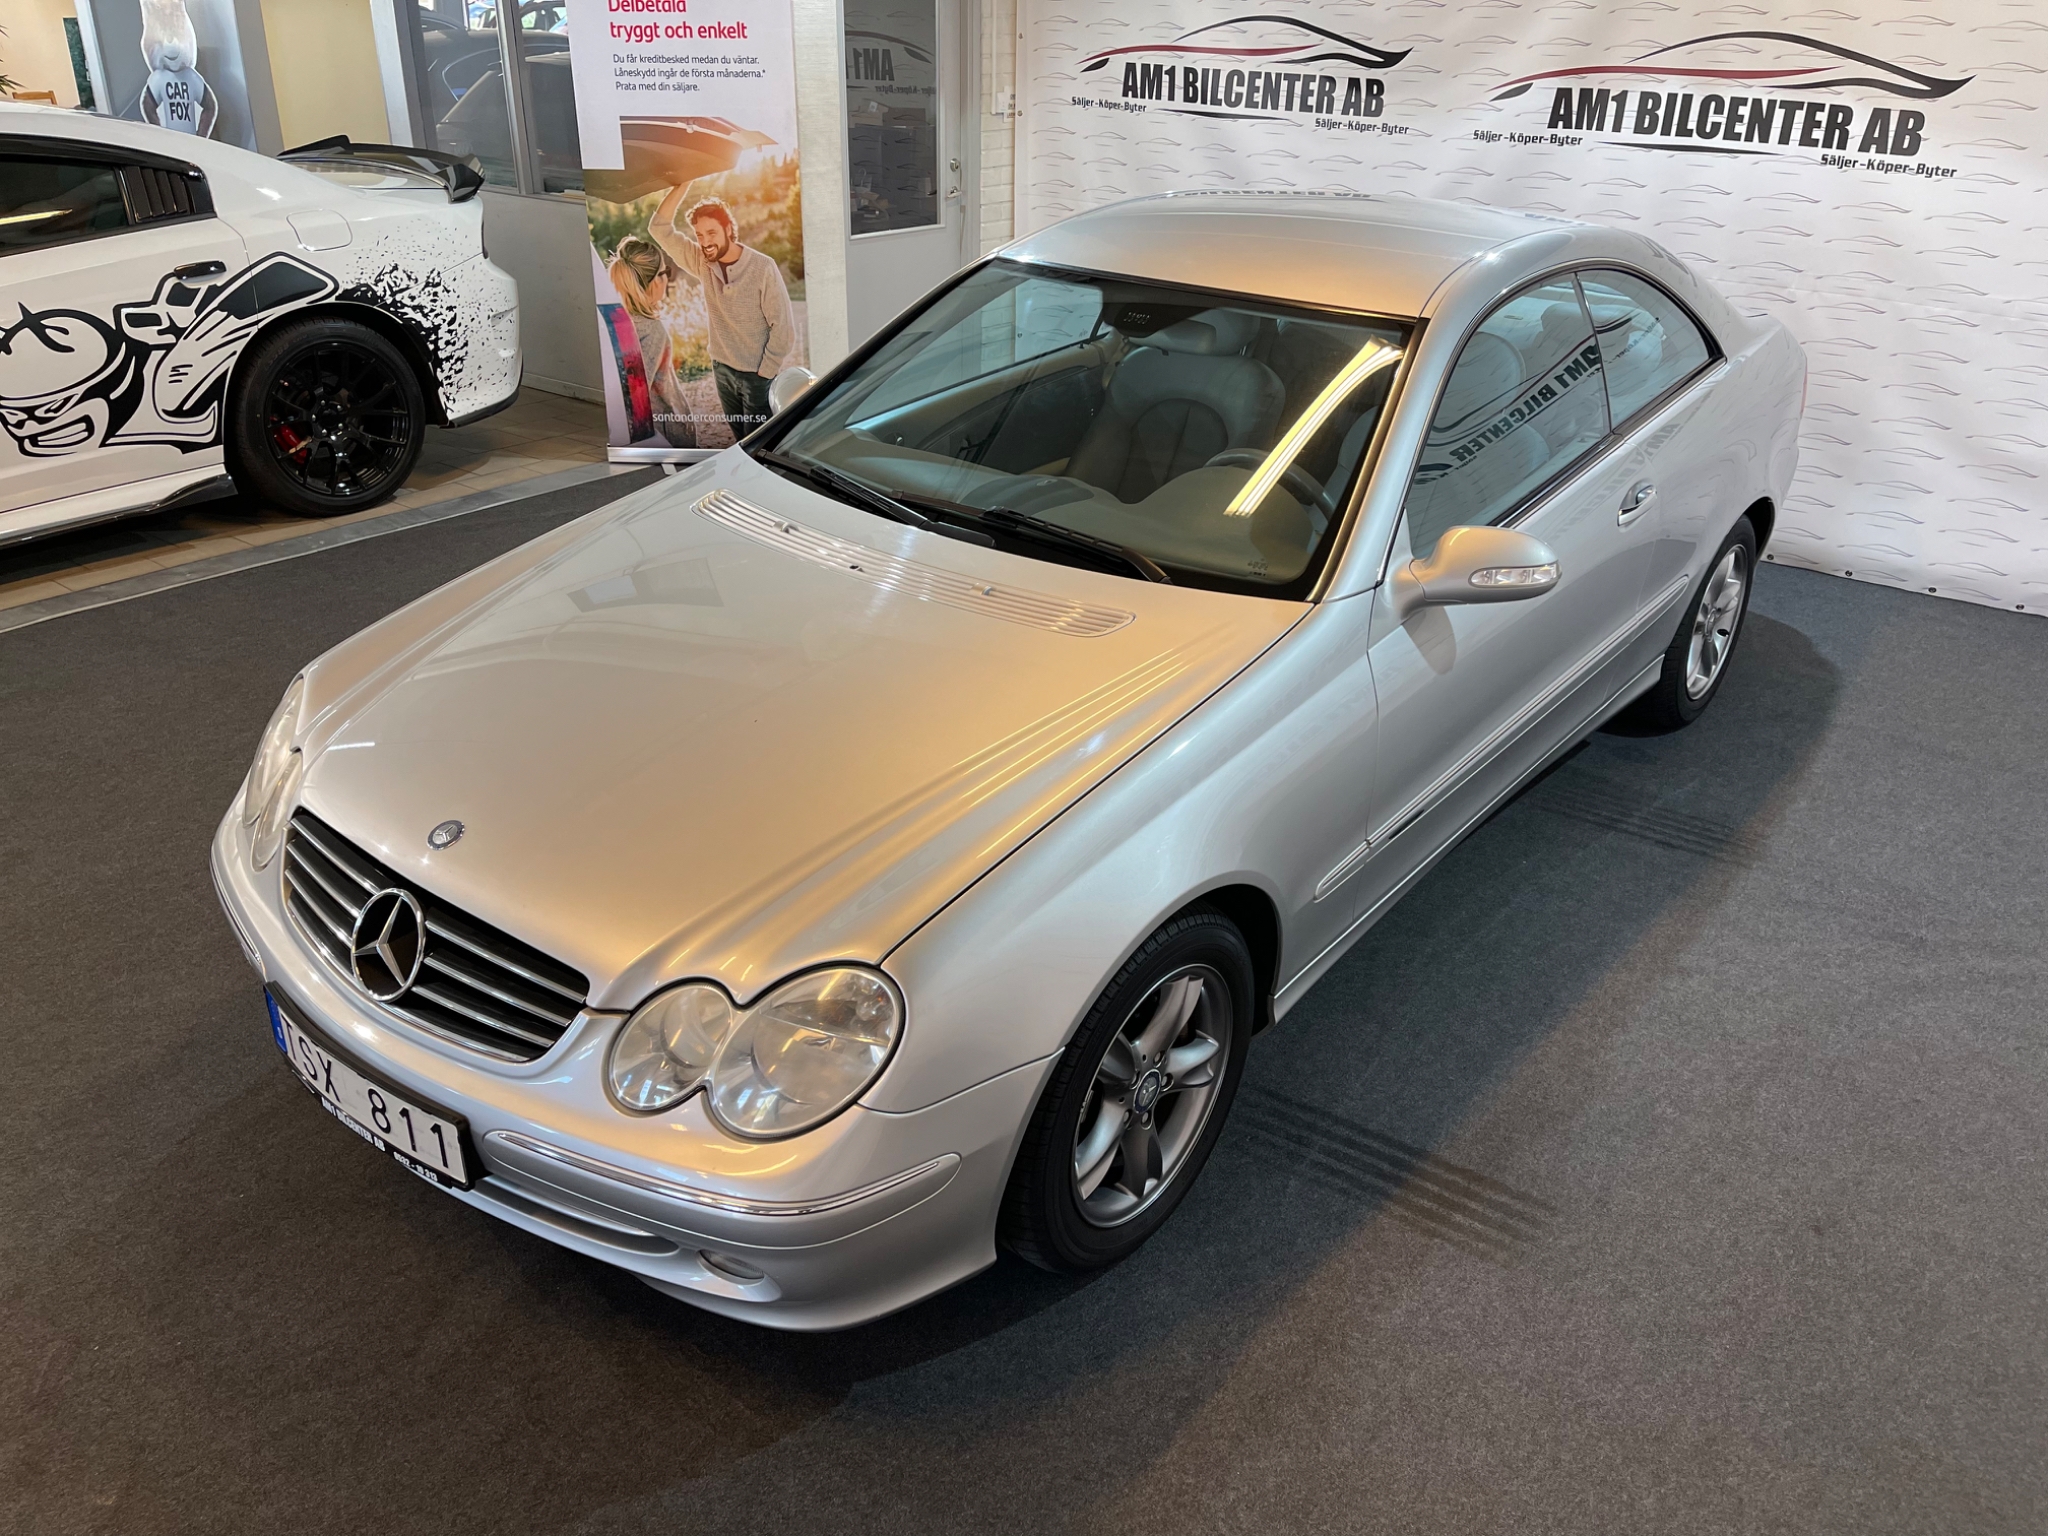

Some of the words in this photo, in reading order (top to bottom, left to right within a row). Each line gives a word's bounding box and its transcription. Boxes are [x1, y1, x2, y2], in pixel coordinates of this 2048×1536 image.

[608, 0, 687, 13] Delbetala
[609, 21, 661, 43] tryggt
[664, 21, 694, 39] och
[697, 21, 748, 39] enkelt
[613, 54, 625, 64] Du
[626, 53, 638, 64] får
[639, 54, 690, 64] kreditbesked
[691, 55, 719, 64] medan
[720, 55, 732, 65] du
[733, 55, 760, 65] väntar.
[614, 67, 656, 79] Låneskydd
[658, 67, 678, 80] ingår
[679, 69, 690, 78] de
[691, 68, 715, 78] första
[165, 81, 190, 101] CAR
[615, 81, 637, 91] Prata
[638, 82, 657, 91] med
[658, 82, 671, 91] din
[672, 82, 700, 94] säljare.
[1122, 62, 1176, 102] AM1
[1183, 66, 1337, 115] BILCENTER
[1341, 76, 1385, 118] AB
[169, 101, 191, 122] FOX
[1071, 96, 1147, 113] Säljer-Köper-Byter
[1314, 118, 1410, 135] Säljer-Köper-Byter
[1547, 87, 1629, 133] AM1
[1633, 91, 1854, 151] BILCENTER
[1857, 107, 1926, 157] AB
[1472, 129, 1584, 147] Säljer-Köper-Byter
[1820, 153, 1958, 178] Säljer-Köper-Byter
[652, 412, 768, 423] santanderconsumer.se
[280, 1013, 341, 1103] TSX
[367, 1087, 449, 1169] 811
